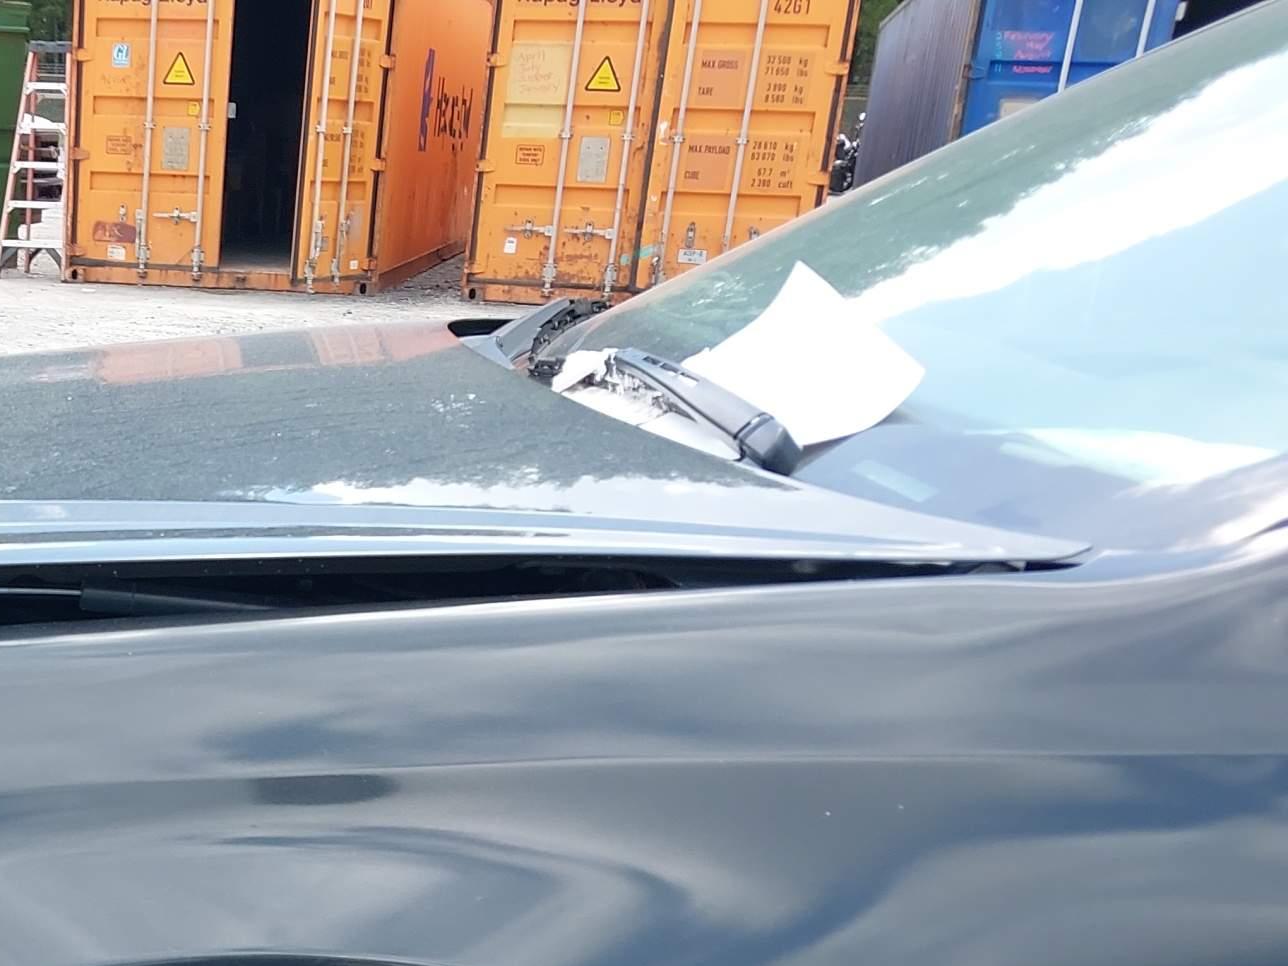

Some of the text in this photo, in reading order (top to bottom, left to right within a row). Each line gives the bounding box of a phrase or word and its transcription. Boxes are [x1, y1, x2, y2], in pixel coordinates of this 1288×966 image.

[774, 0, 811, 14] 42G1
[701, 60, 716, 70] MAX
[717, 60, 739, 71] GROSS
[697, 86, 714, 96] TARE
[688, 145, 704, 154] MAX
[704, 145, 731, 155] PAYLOAD
[784, 143, 794, 153] kg
[684, 170, 700, 180] CUBE
